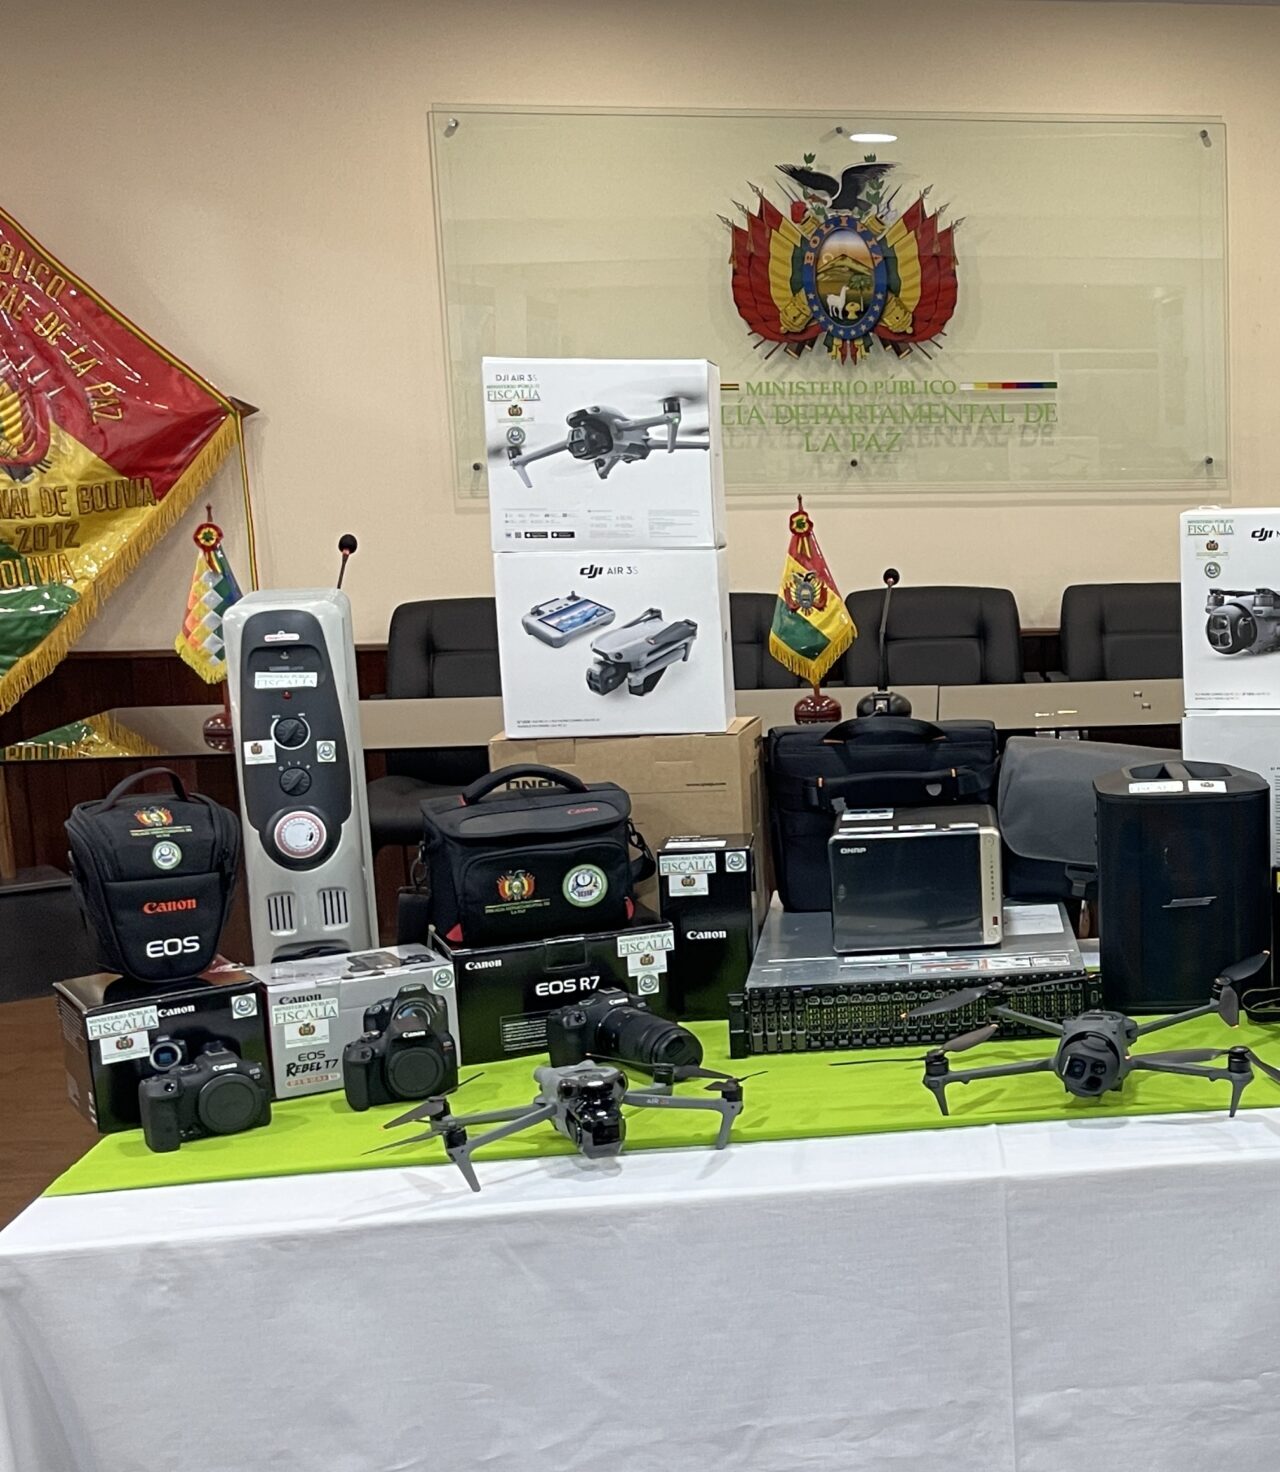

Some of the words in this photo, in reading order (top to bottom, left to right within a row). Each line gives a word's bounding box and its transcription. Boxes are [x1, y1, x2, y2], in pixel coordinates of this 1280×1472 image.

[66, 345, 98, 378] LA
[84, 382, 124, 425] PAZ
[495, 373, 509, 382] DJI
[511, 373, 525, 382] AIR
[745, 379, 868, 396] MINISTERIO
[873, 374, 957, 396] PÚBLICO
[487, 387, 541, 400] FISCALÍA
[774, 402, 1014, 426] DEPARTAMENTAL
[1024, 402, 1058, 423] DE
[804, 432, 839, 453] LA
[851, 432, 902, 452] PAZ
[39, 485, 72, 518] DE
[76, 477, 157, 515] BOLIVIA
[1187, 523, 1235, 534] FISCALÍA
[607, 566, 624, 575] AIR
[627, 566, 639, 575] 3S
[567, 806, 599, 816] Canon
[661, 859, 715, 871] FISCALÍA
[143, 898, 197, 914] Canon
[686, 930, 727, 940] Canon
[146, 936, 200, 958] EOS
[619, 936, 673, 955] FISCALÍA
[465, 959, 502, 971] Canon
[535, 978, 577, 996] EOS
[579, 976, 601, 991] R7
[278, 993, 322, 1006] Canon
[157, 1004, 196, 1018] Canon
[275, 1004, 337, 1024] FISCALÍA
[89, 1014, 157, 1036] FISCALÍA
[297, 1051, 326, 1062] EOS
[286, 1062, 322, 1077] REBEL
[324, 1058, 339, 1069] T7
